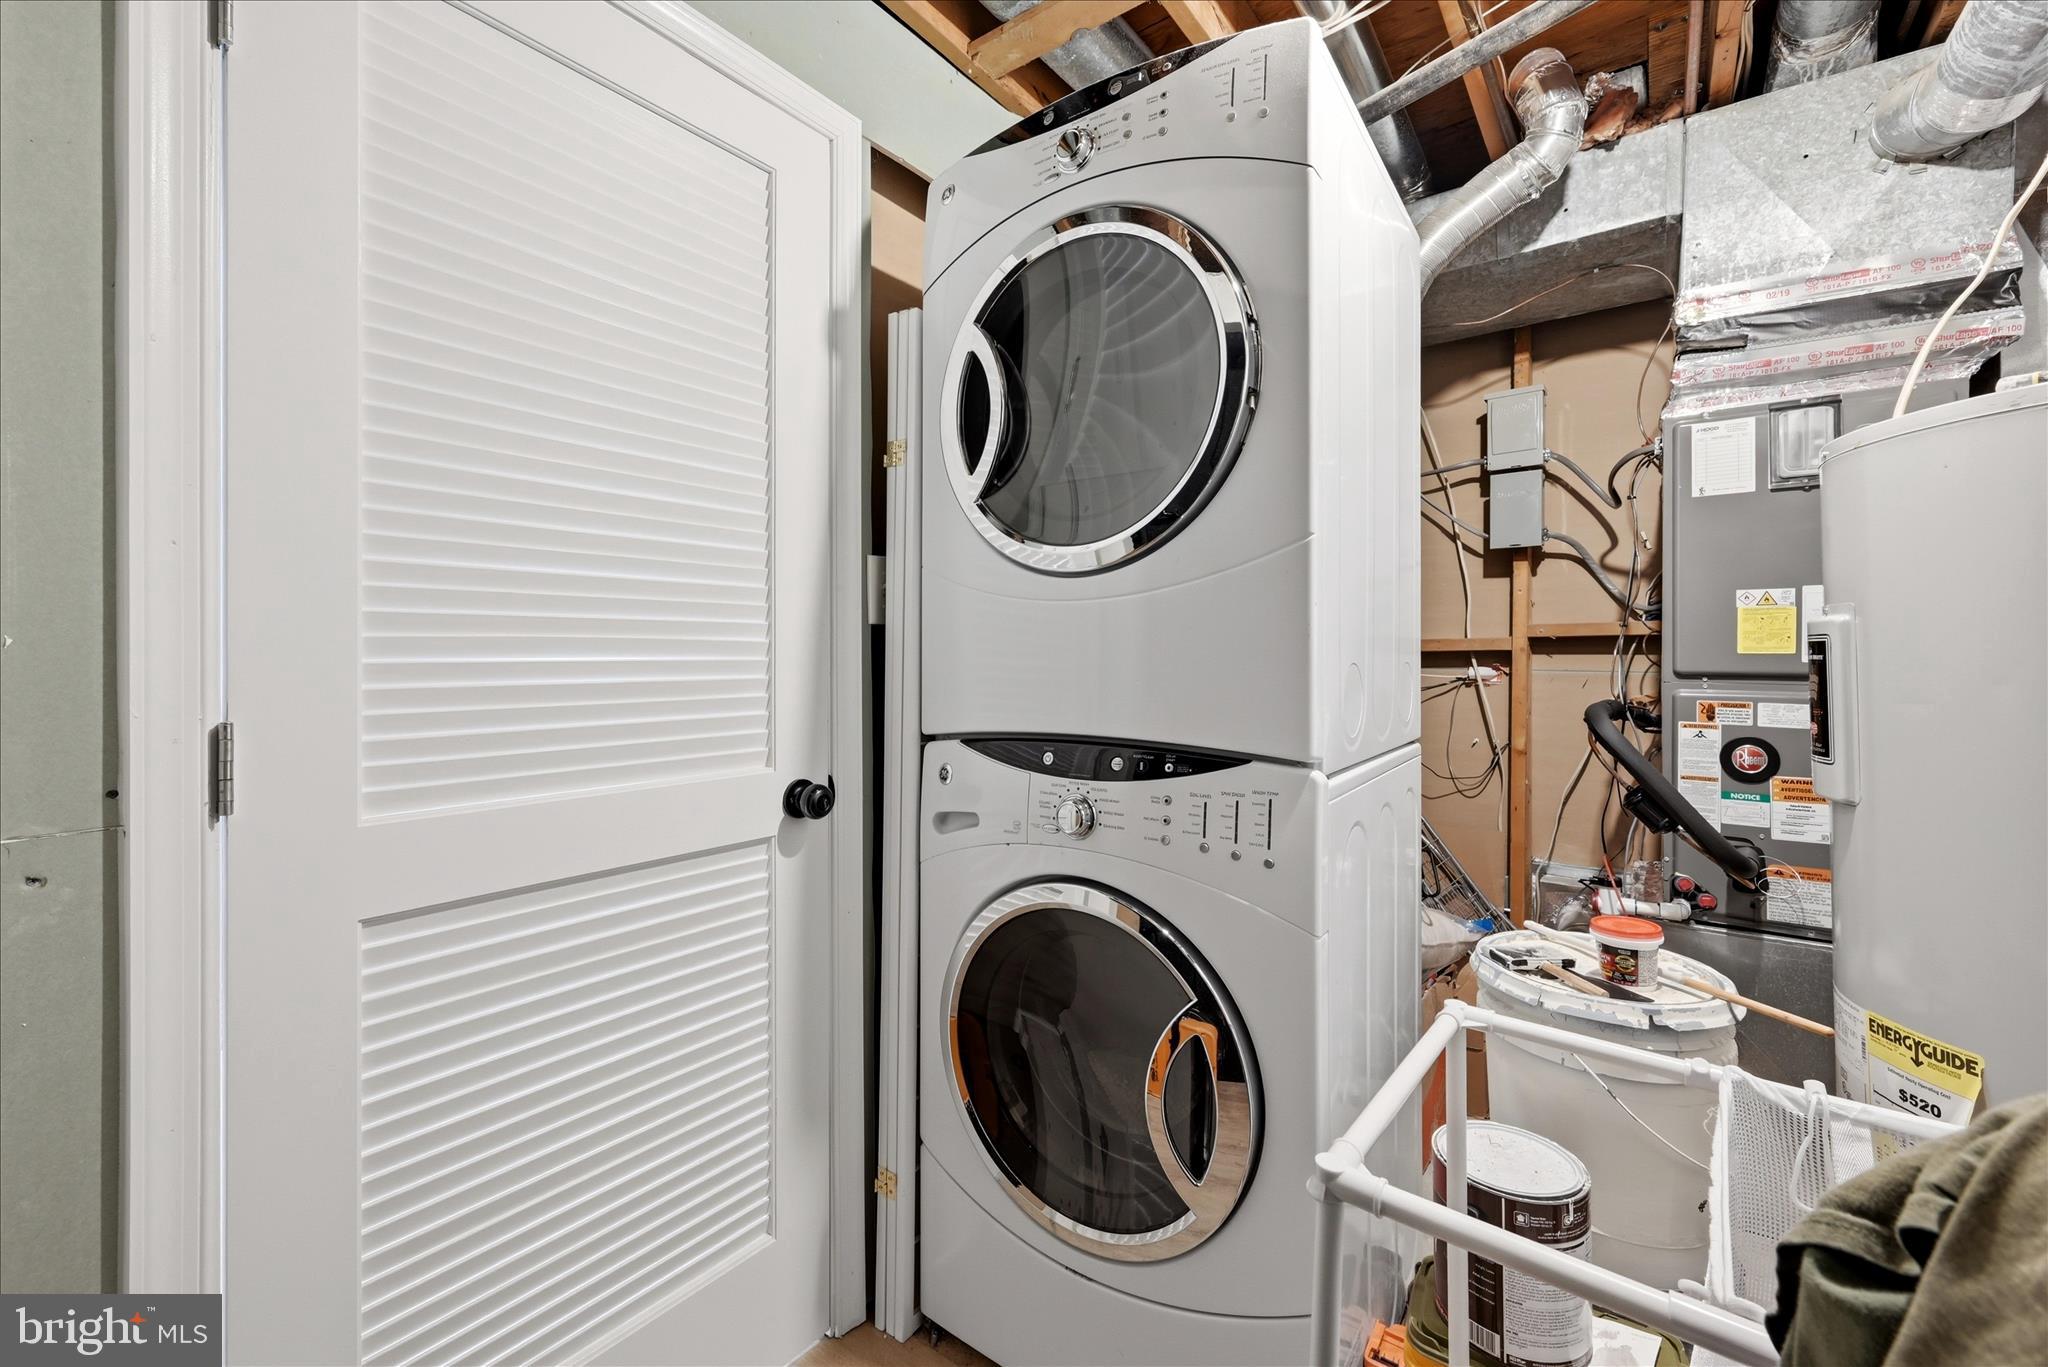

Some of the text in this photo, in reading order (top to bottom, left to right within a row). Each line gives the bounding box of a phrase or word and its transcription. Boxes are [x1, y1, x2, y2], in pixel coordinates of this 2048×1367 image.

[1766, 288, 1790, 299] 02/19
[2007, 324, 2022, 332] 100
[1736, 746, 1766, 768] Rheem
[1730, 792, 1761, 801] NOTICE
[1898, 1088, 1942, 1119] $520
